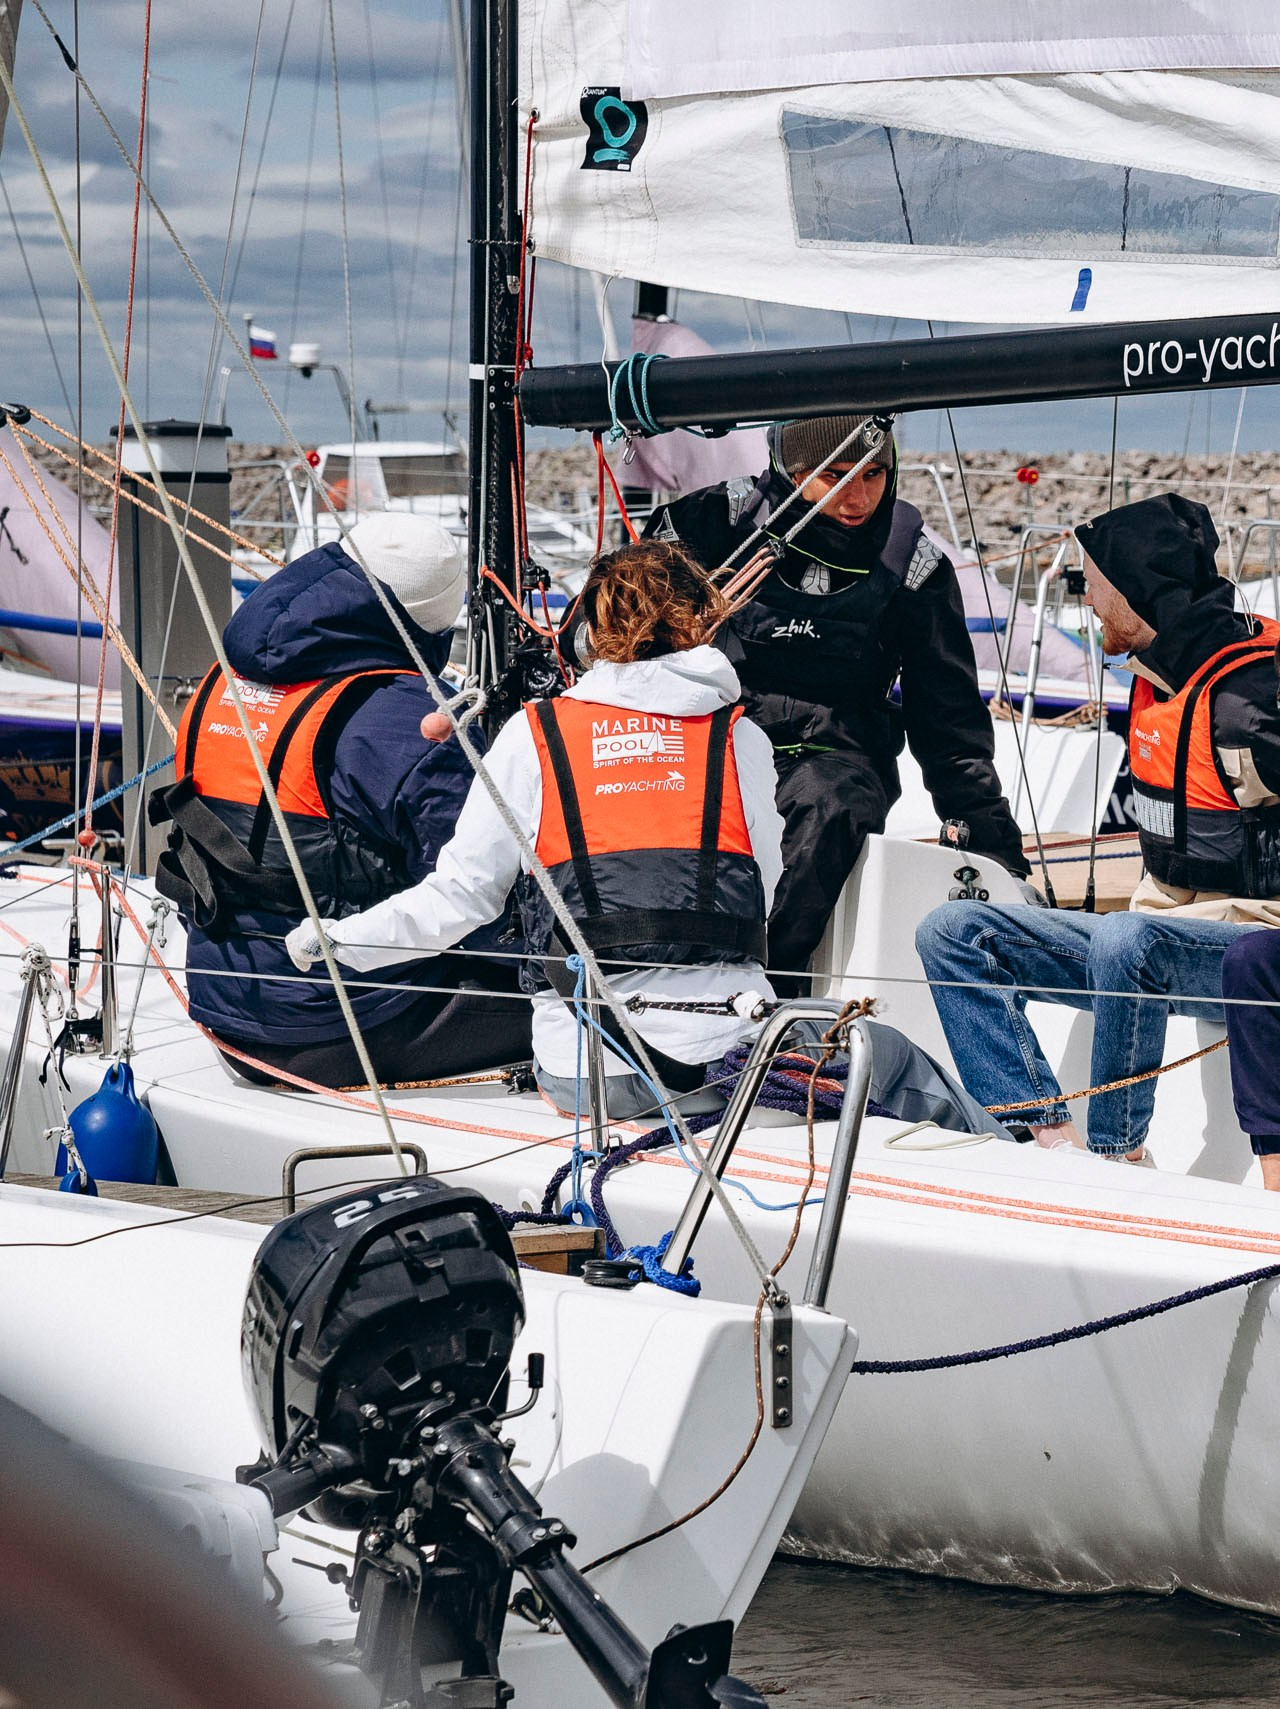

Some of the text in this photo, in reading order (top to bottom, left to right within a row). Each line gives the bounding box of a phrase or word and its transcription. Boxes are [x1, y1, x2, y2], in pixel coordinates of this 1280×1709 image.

[208, 722, 267, 742] PROYACHNG
[592, 716, 683, 737] MARINE
[597, 739, 649, 754] POOL
[593, 760, 620, 769] SPIRIT
[623, 757, 634, 765] OF
[595, 780, 685, 796] PROYACHTING
